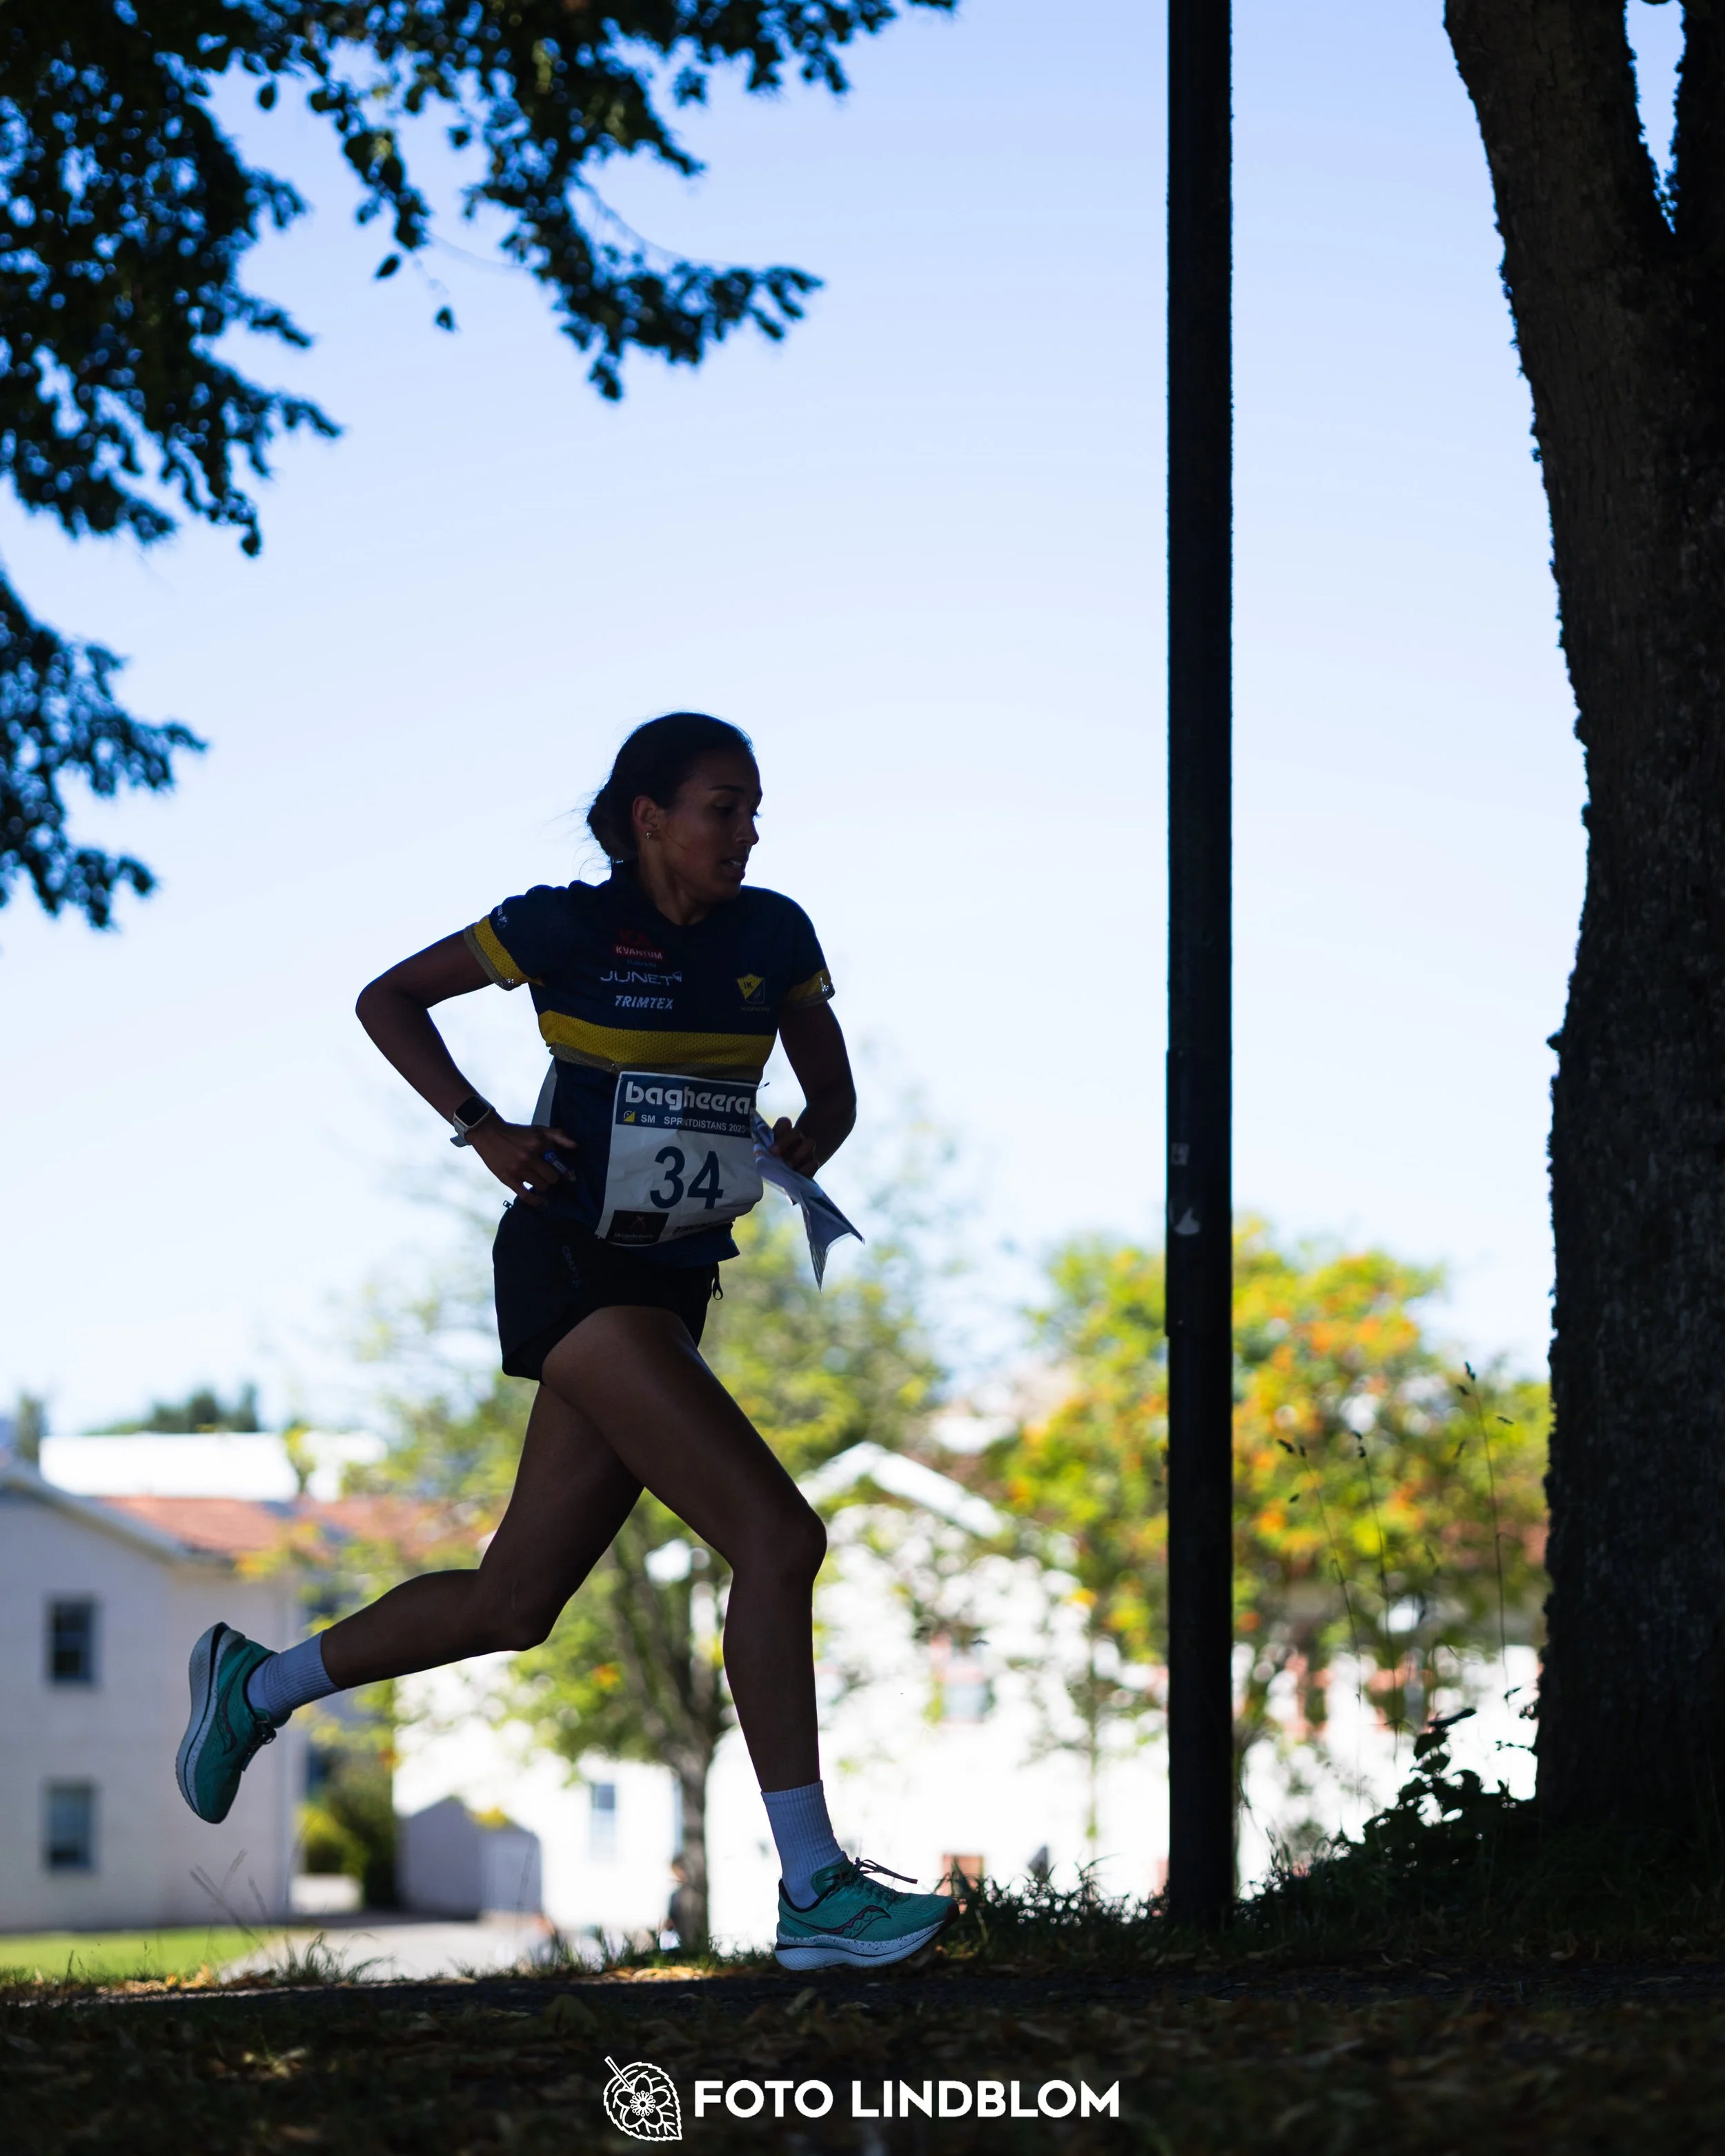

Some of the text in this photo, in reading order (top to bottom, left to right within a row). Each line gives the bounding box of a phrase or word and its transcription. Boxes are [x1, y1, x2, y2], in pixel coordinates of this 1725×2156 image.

[601, 969, 673, 986] JUNET
[615, 995, 674, 1010] TRIMTEX
[625, 1081, 751, 1115] bagheera
[640, 1114, 656, 1123] SM
[664, 1116, 727, 1131] SPRNTDISTANS
[650, 1146, 723, 1209] 34
